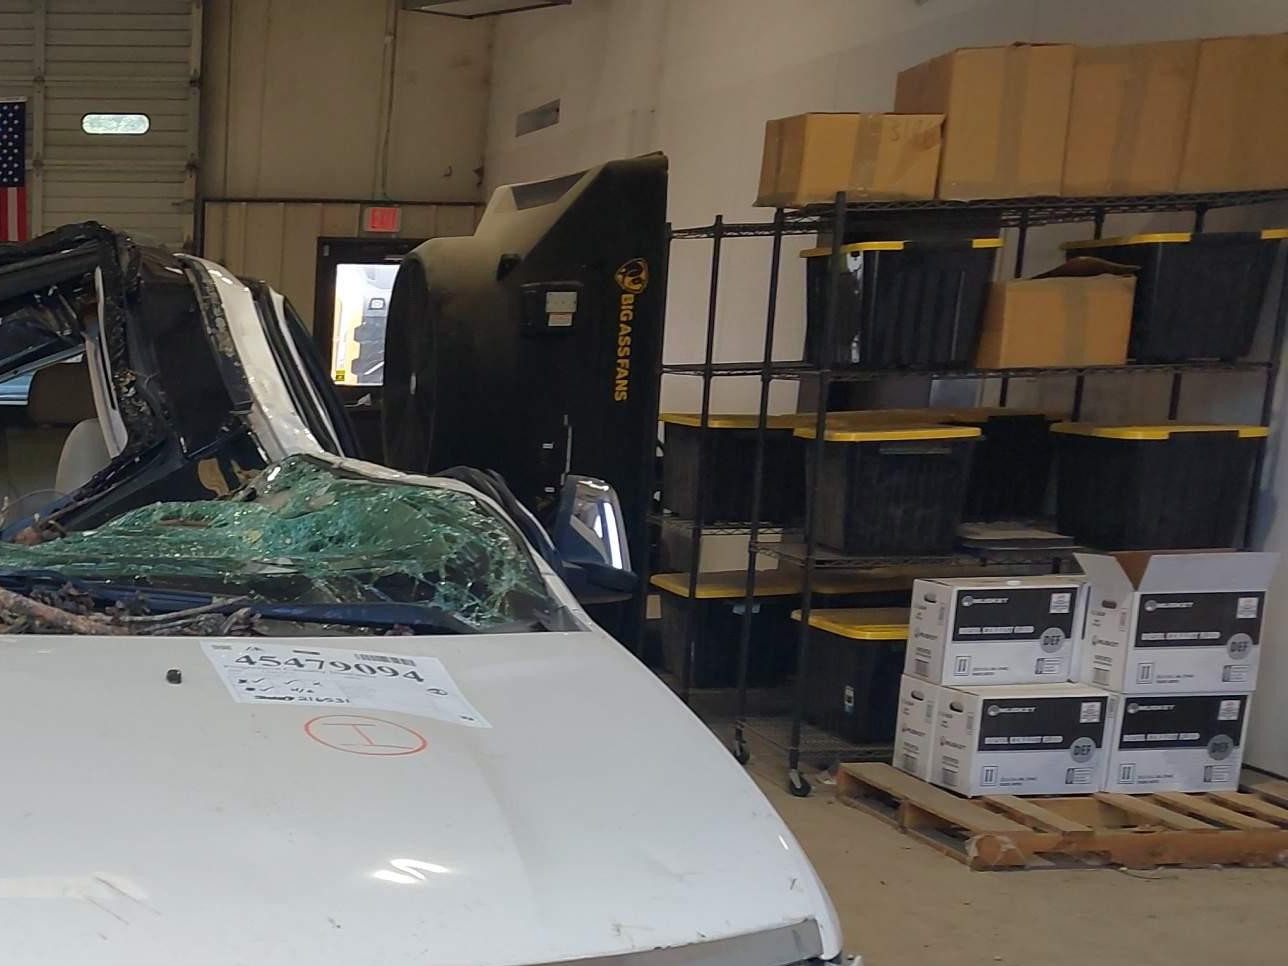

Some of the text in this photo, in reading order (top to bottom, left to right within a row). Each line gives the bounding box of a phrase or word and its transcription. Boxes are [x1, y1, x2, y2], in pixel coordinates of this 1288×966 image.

[614, 293, 634, 401] BIG ASS FANS
[1043, 635, 1061, 646] DEF
[235, 654, 425, 683] 45479094
[1073, 744, 1092, 756] DEF
